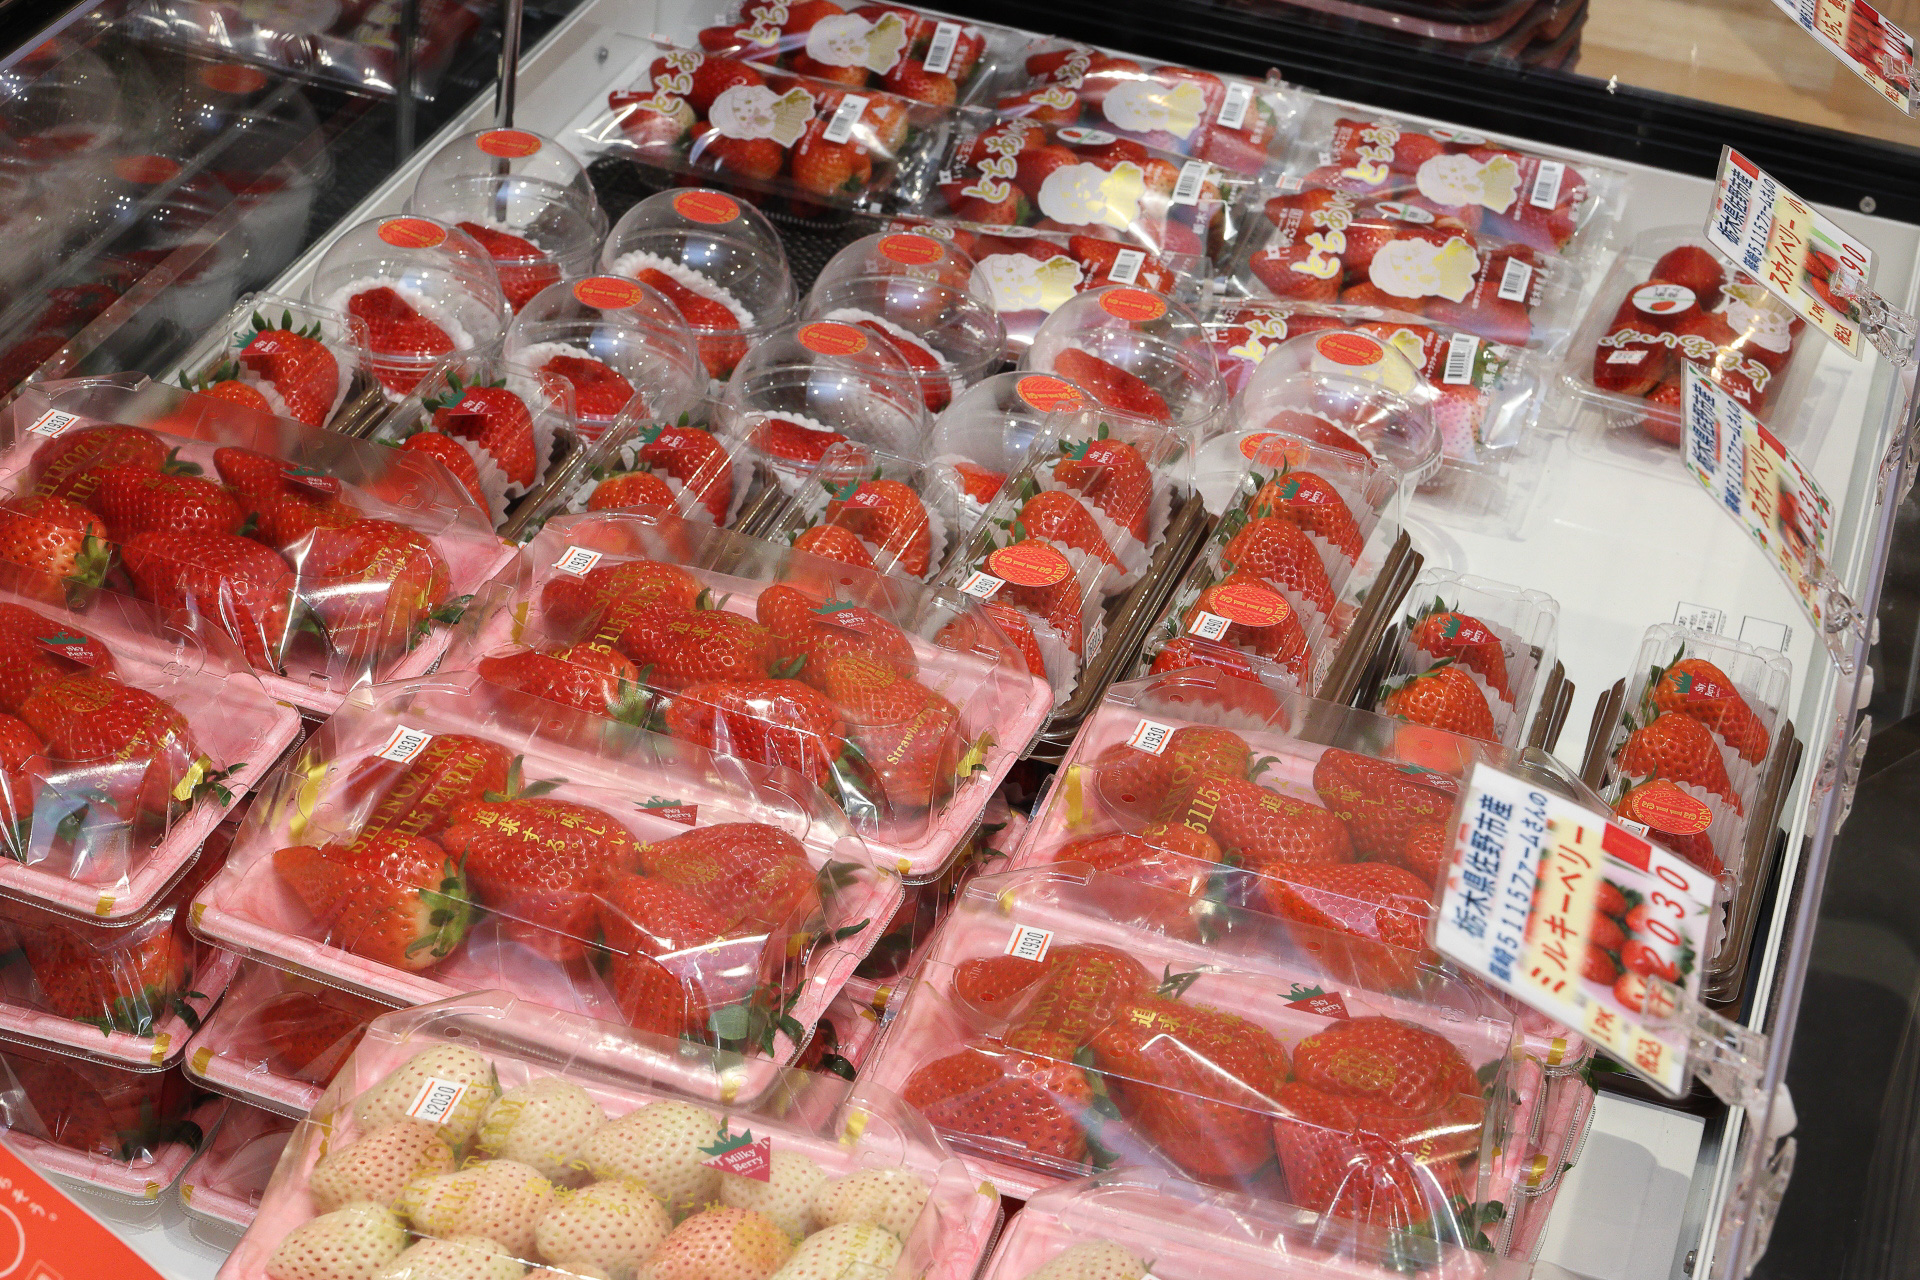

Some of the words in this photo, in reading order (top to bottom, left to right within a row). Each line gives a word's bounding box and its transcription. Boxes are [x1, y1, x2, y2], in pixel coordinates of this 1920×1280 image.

[1717, 167, 1753, 246] 栃木県佐野市産
[1769, 219, 1802, 294] スカイベリー
[1749, 437, 1774, 530] スカイベリー
[839, 616, 864, 625] Berry
[390, 735, 421, 757] ¥1930
[386, 809, 434, 849] 5115
[422, 753, 486, 815] FARM
[1184, 786, 1221, 834] 5115
[1692, 806, 1712, 831] FARM
[472, 810, 579, 851] 追求する。
[1450, 792, 1515, 940] 栃木県佐野市産
[1531, 826, 1592, 994] ミルキーベリー
[1017, 931, 1044, 955] ¥1930
[1314, 1003, 1340, 1013] Berry
[1591, 1008, 1616, 1044] 1PK
[422, 1086, 456, 1115] ¥2030
[725, 1148, 756, 1165] Milky
[732, 1155, 764, 1171] Berry
